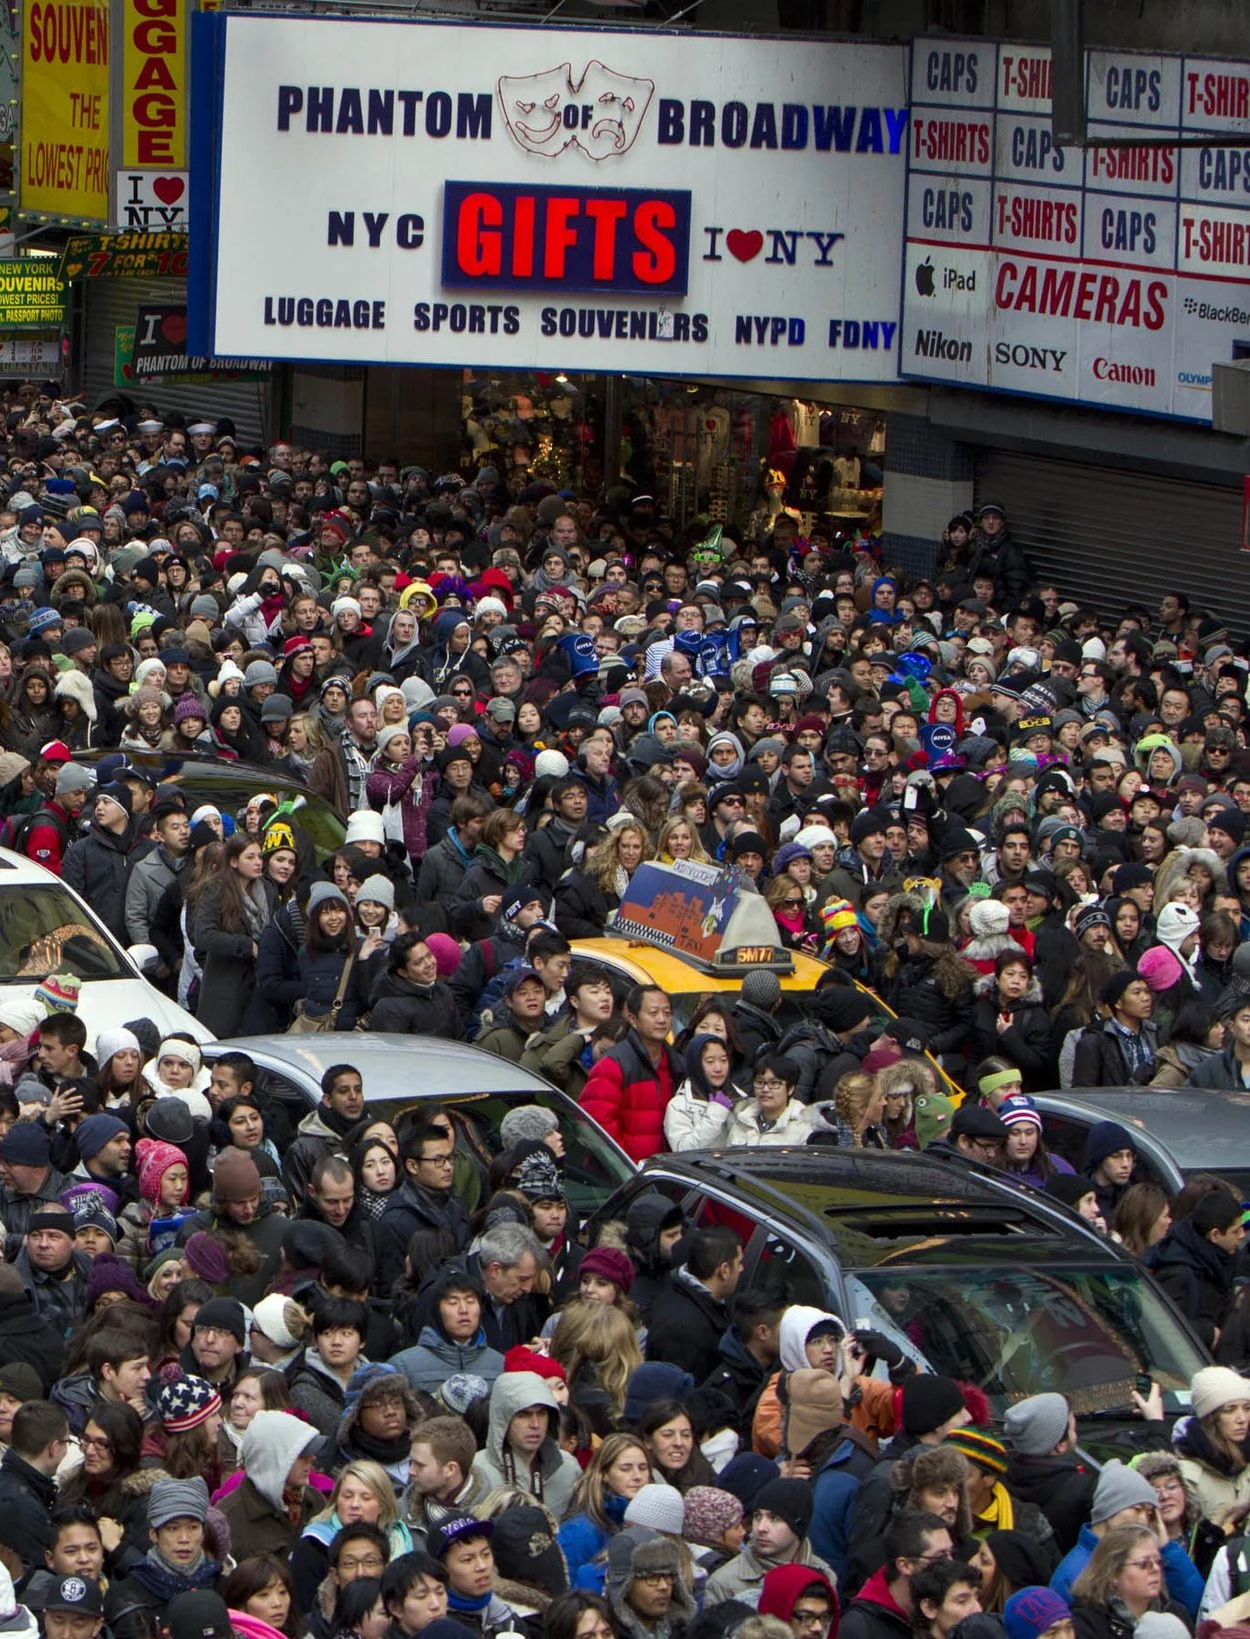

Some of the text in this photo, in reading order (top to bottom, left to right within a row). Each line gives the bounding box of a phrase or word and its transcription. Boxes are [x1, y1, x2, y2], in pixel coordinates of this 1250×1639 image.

[926, 51, 978, 93] CAPS
[1003, 56, 1053, 99] T-SHI
[1105, 66, 1161, 112] CAPS
[70, 93, 101, 130] THE
[277, 85, 910, 154] PHANTOM OF BROADWAY
[913, 119, 990, 164] T-SHIRTS
[1012, 126, 1065, 172] CAPS
[28, 141, 83, 190] LOWEST
[1092, 146, 1174, 184] T-SHIRTS
[1199, 147, 1250, 193] CAPS
[127, 176, 144, 204] I
[124, 207, 184, 234] NY
[922, 188, 973, 232] CAPS
[997, 194, 1077, 244] T-SHIRTS
[327, 192, 845, 285] NYC GIFTS I NY
[1101, 208, 1157, 254] CAPS
[24, 263, 54, 274] YORK
[86, 251, 111, 277] 7
[113, 254, 147, 268] FOR
[943, 268, 976, 291] iPad
[26, 293, 59, 305] PRICES!
[995, 262, 1168, 331] CAMERAS
[6, 309, 40, 322] PASSPORT
[40, 309, 63, 321] PHOTO
[140, 315, 162, 346] I
[263, 296, 898, 350] LUGGAGE SPORTS SOUVENIRS NYPD FDNY
[136, 354, 188, 374] PHANTOM
[915, 329, 973, 362] Nikon
[995, 342, 1067, 372] SONY
[1093, 357, 1156, 387] Canon
[1178, 372, 1212, 385] OLYMP
[679, 935, 703, 953] TAXI
[738, 947, 773, 964] 5M77
